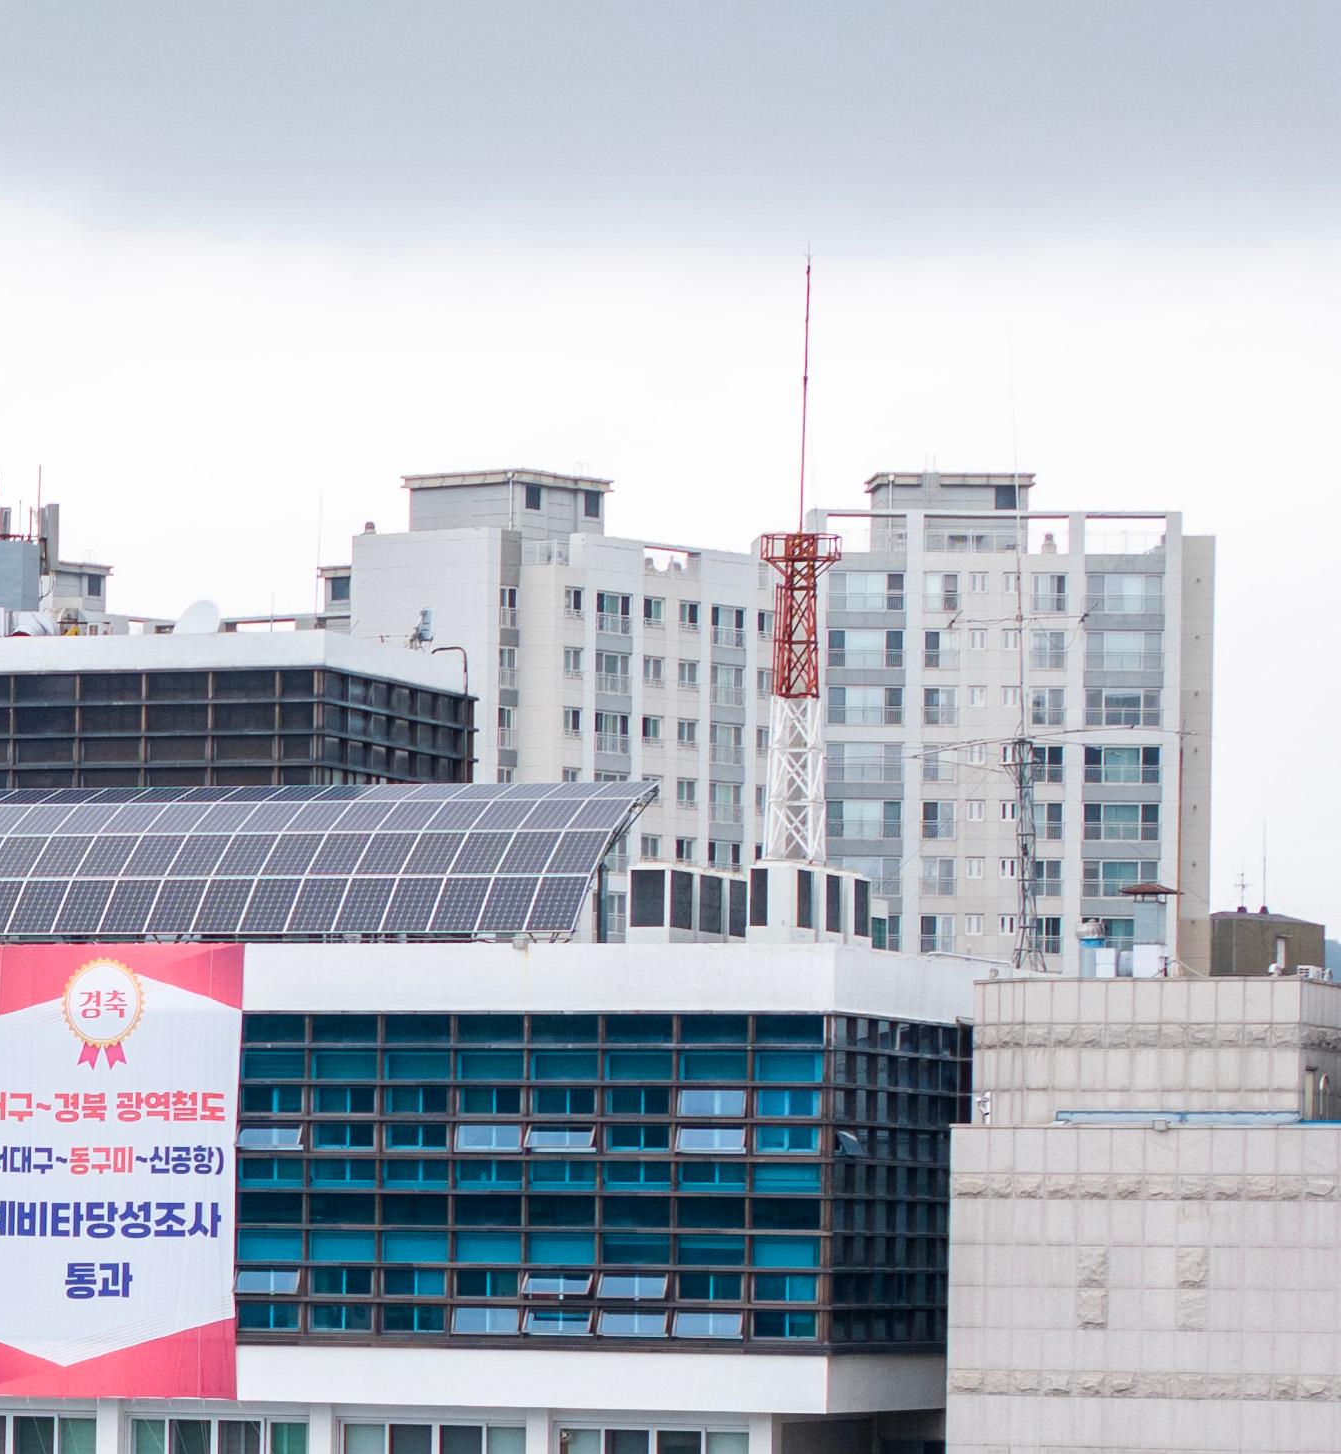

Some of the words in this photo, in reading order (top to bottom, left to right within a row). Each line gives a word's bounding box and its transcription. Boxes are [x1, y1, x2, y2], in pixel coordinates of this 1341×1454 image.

[80, 990, 128, 1019] 경축
[116, 1091, 226, 1122] 광역철도
[65, 1262, 133, 1299] 통과
